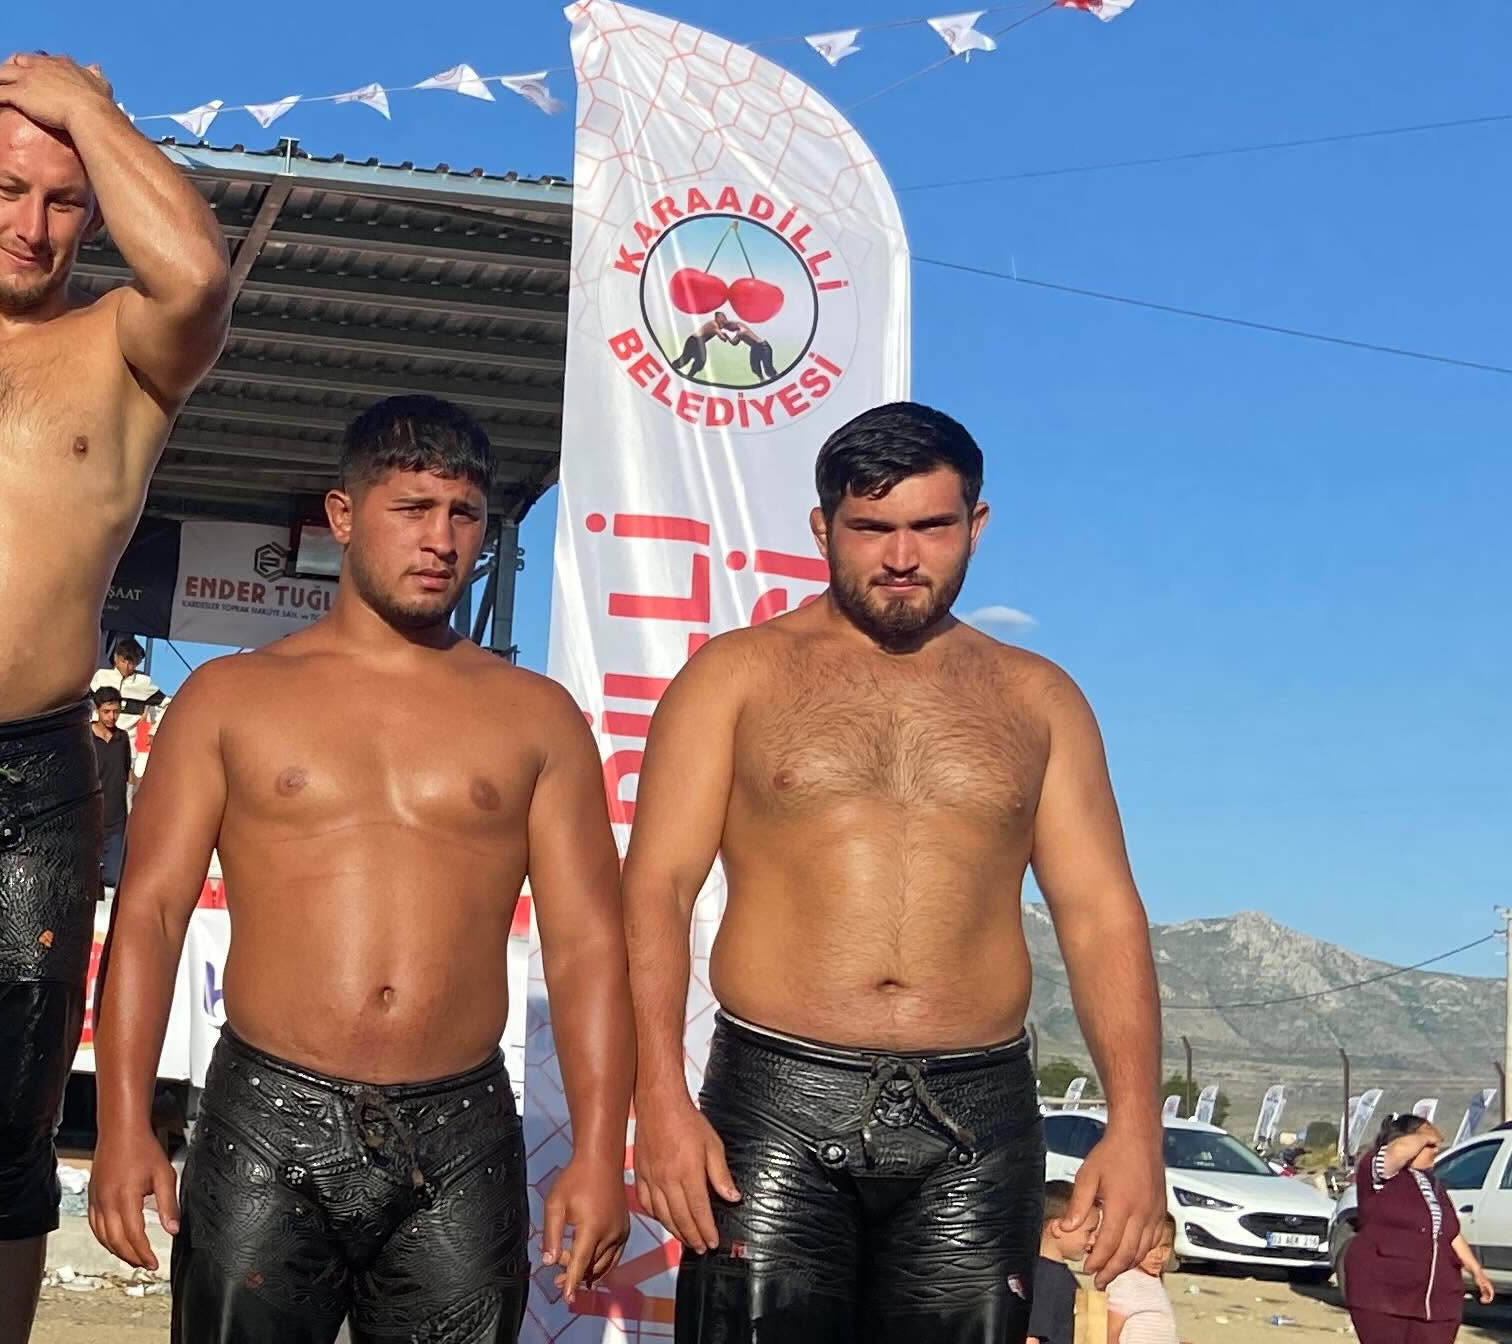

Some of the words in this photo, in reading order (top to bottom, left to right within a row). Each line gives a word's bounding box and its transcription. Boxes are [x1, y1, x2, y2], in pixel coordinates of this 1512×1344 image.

[614, 186, 849, 293] KARAADİLLİ
[608, 328, 843, 428] BELEDİYESİ
[185, 576, 266, 604] ENDER
